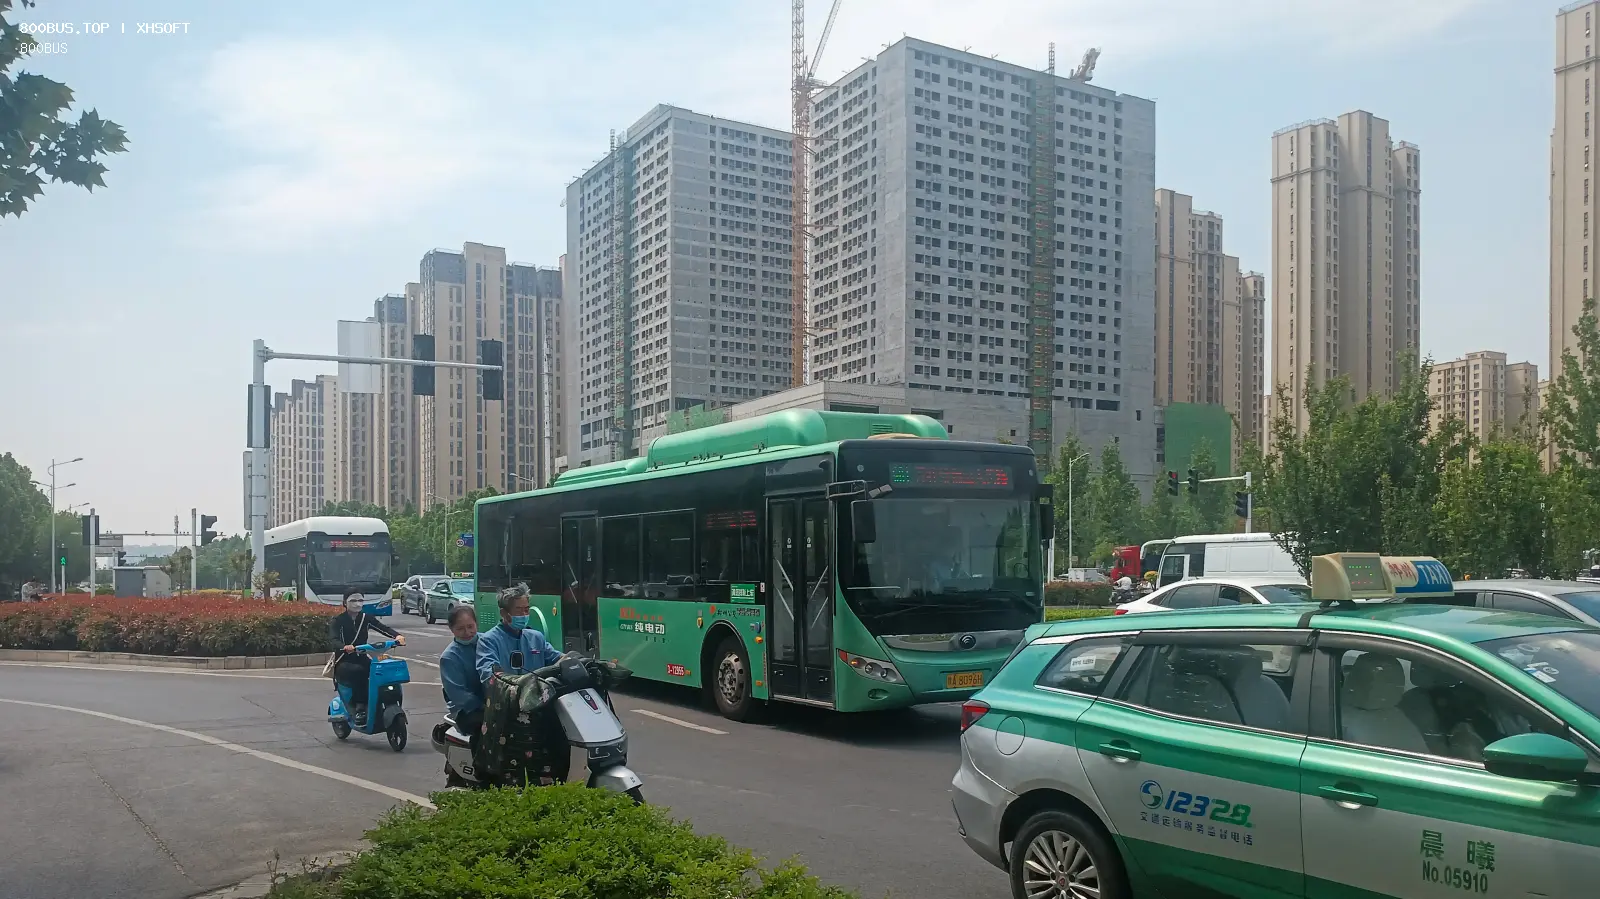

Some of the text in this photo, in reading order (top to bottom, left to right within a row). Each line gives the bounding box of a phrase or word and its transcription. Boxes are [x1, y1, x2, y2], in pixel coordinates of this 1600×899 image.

[1417, 564, 1450, 585] TAXI
[634, 621, 665, 635] 纯电动
[1164, 790, 1252, 827] 12328
[1422, 860, 1488, 893] No.05910
